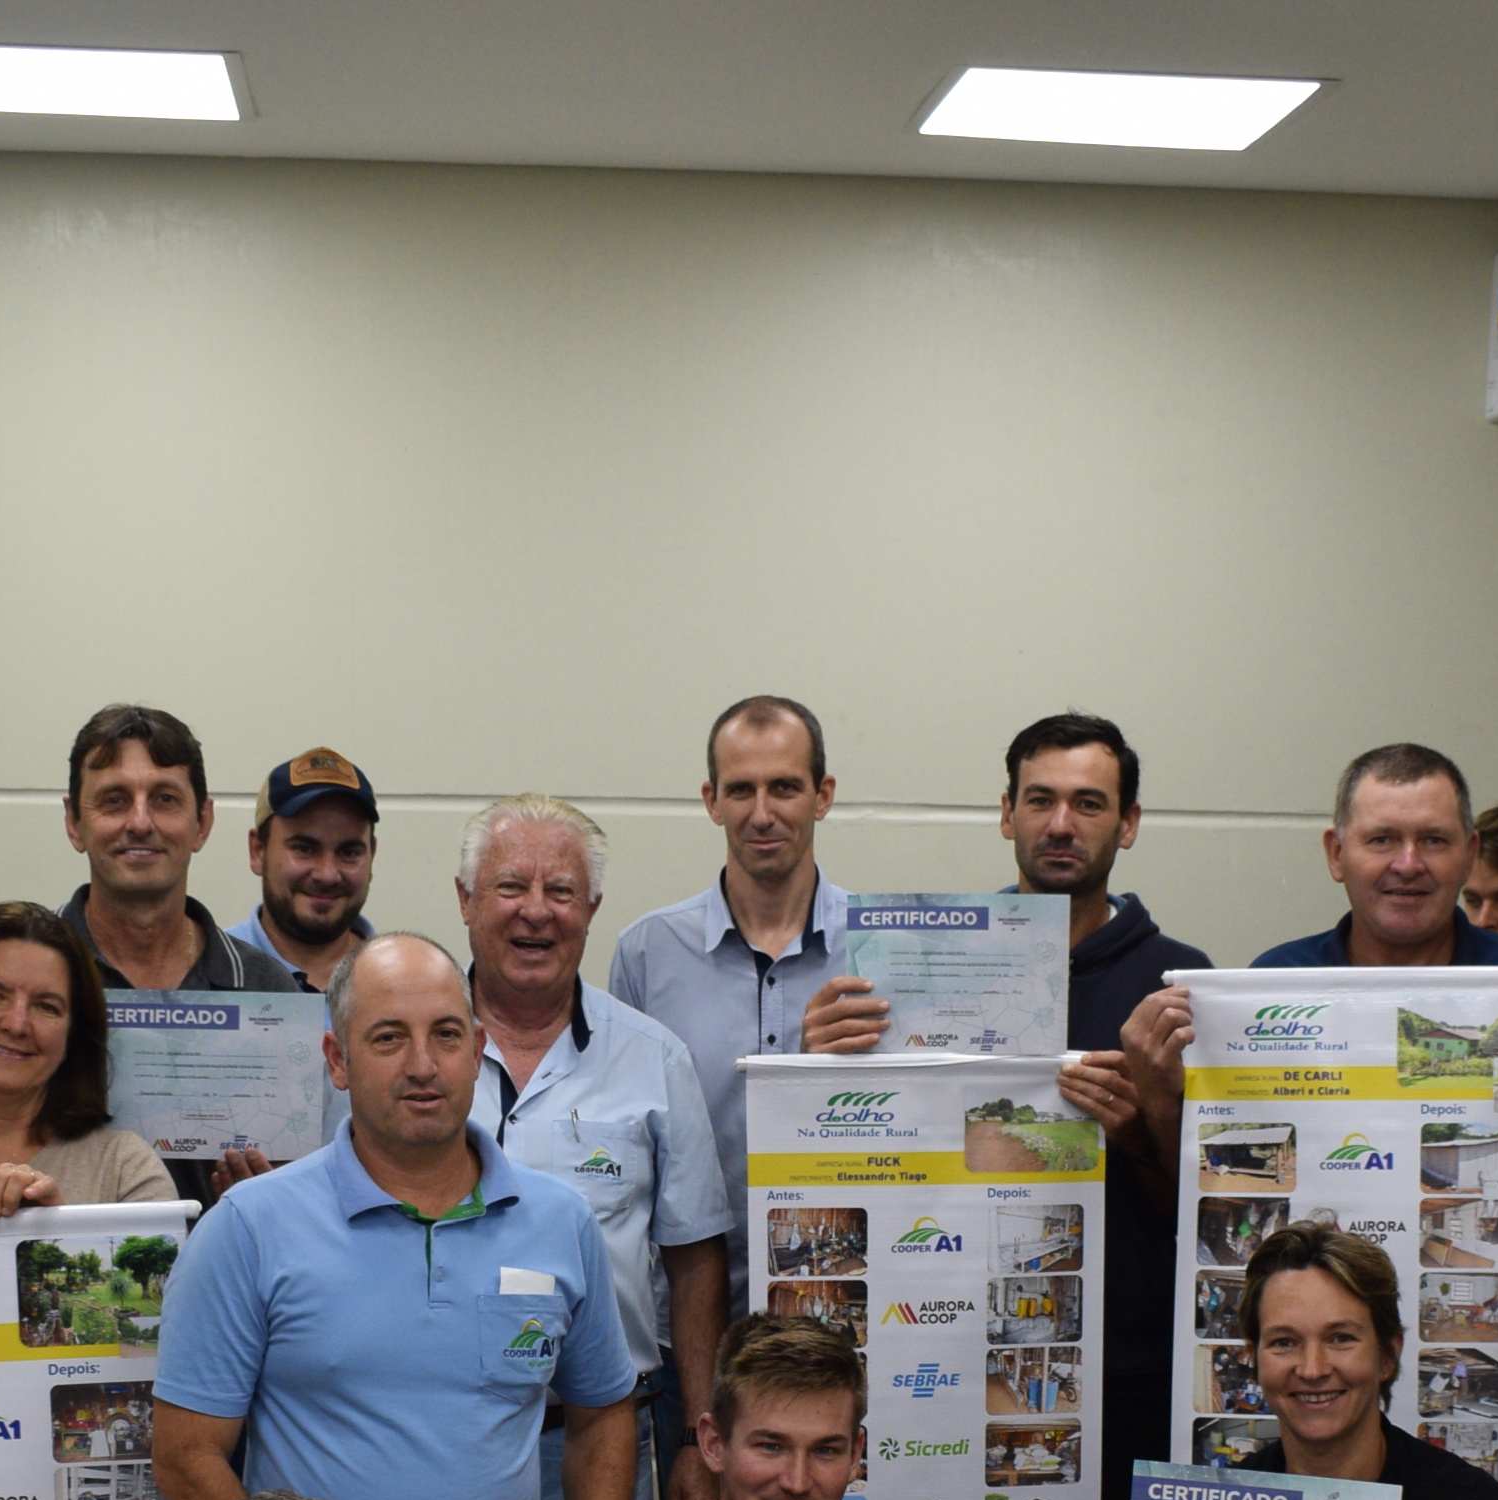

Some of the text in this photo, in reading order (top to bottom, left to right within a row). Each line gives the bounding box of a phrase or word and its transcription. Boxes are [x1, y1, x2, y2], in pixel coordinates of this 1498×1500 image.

[859, 911, 978, 926] CERTIFICADO
[926, 1040, 949, 1048] COOP
[1226, 1041, 1349, 1052] Na Qualidade Rural
[1283, 1071, 1301, 1081] DE
[1303, 1071, 1343, 1081] CARLI
[1272, 1086, 1305, 1096] Alberi
[1307, 1088, 1315, 1096] e
[1197, 1105, 1235, 1116] Antes:
[1420, 1104, 1467, 1117] Depois:
[797, 1128, 918, 1139] Na Qualidade Rural
[867, 1156, 901, 1167] FUCK
[1319, 1152, 1393, 1171] COOPER A1
[837, 1172, 896, 1182] Elessandro
[899, 1171, 927, 1182] Tiago
[766, 1190, 804, 1201] Antes:
[987, 1187, 1031, 1199] Depois:
[1348, 1221, 1407, 1233] AURORA
[891, 1235, 963, 1254] COOPER A1
[919, 1301, 975, 1312] AURORA
[919, 1313, 957, 1325] COOP
[502, 1349, 538, 1358] COOPER
[48, 1362, 100, 1377] Depois:
[892, 1373, 961, 1388] SEBRAE
[904, 1439, 970, 1457] Sicredi
